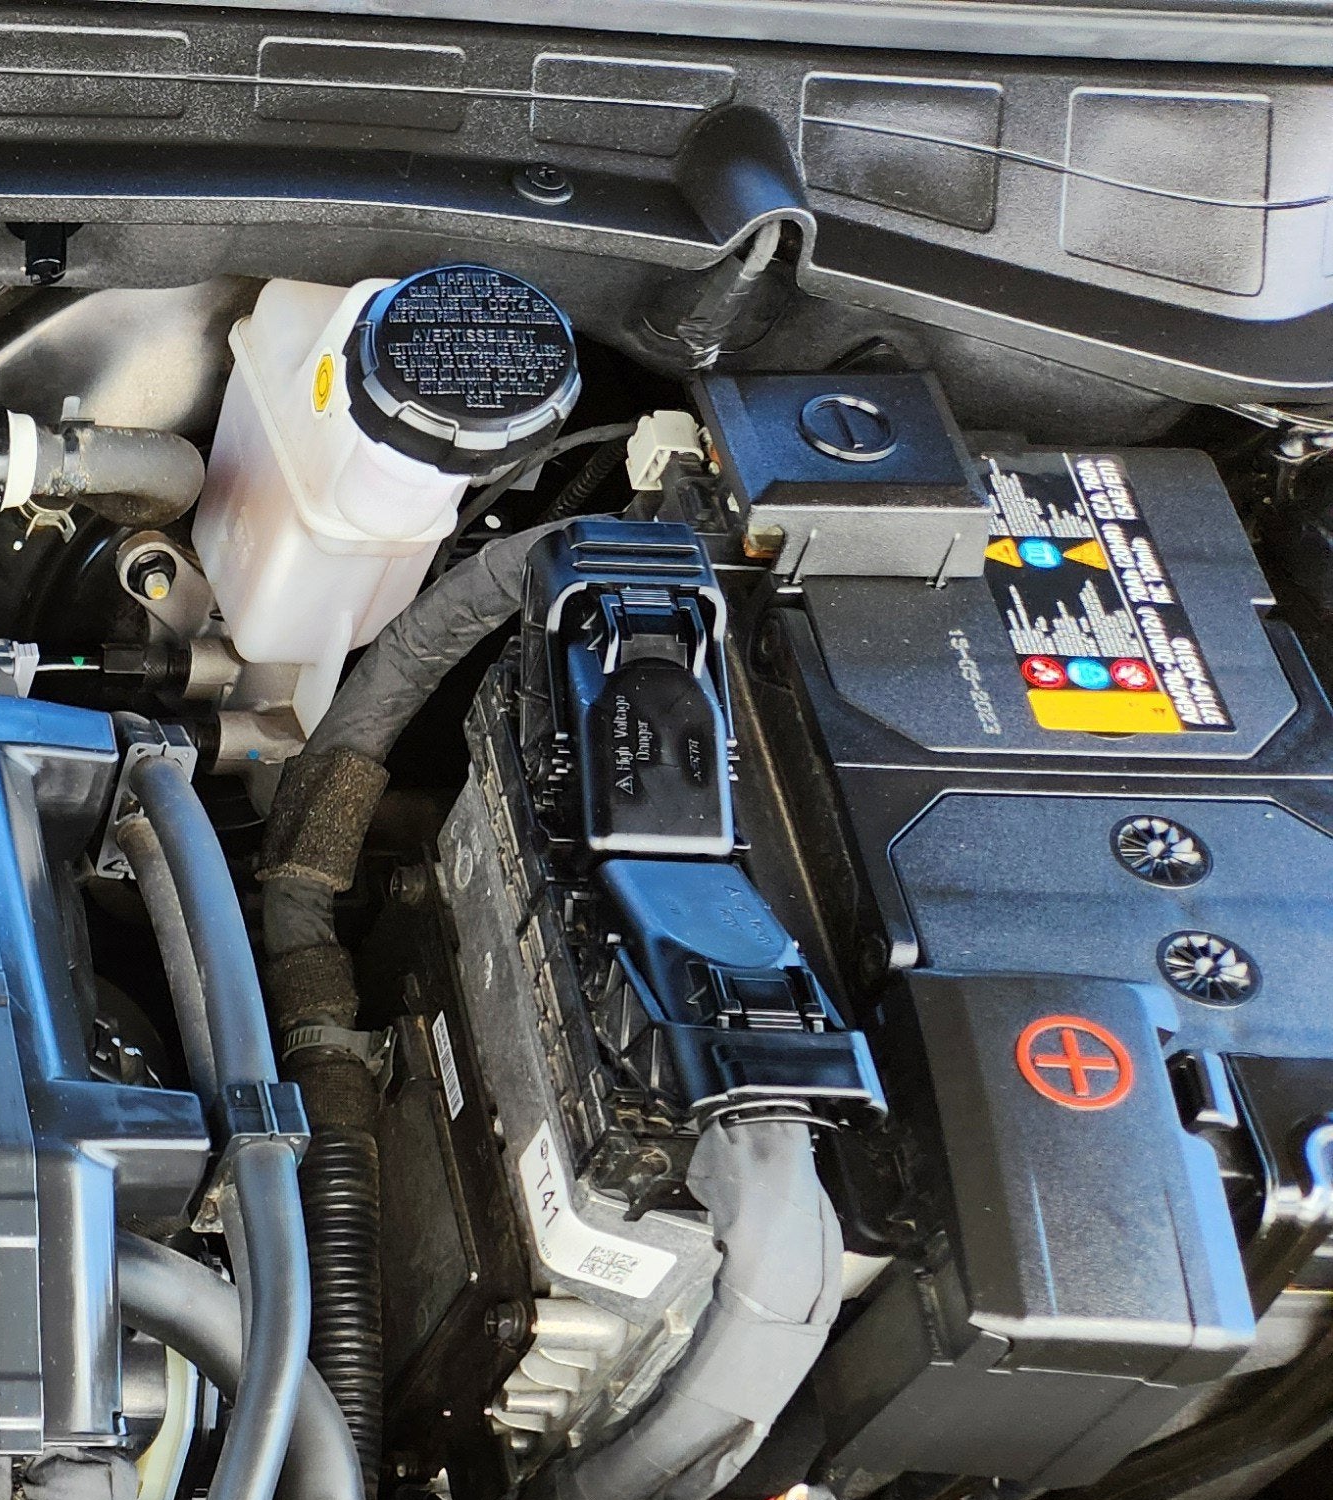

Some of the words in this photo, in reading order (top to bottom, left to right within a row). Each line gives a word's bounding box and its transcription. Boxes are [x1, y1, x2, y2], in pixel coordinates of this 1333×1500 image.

[436, 273, 501, 286] WARNING
[412, 329, 537, 343] AVERTISSEMENT
[613, 694, 631, 739] Voltage
[635, 719, 654, 761] Danger
[614, 746, 633, 771] High
